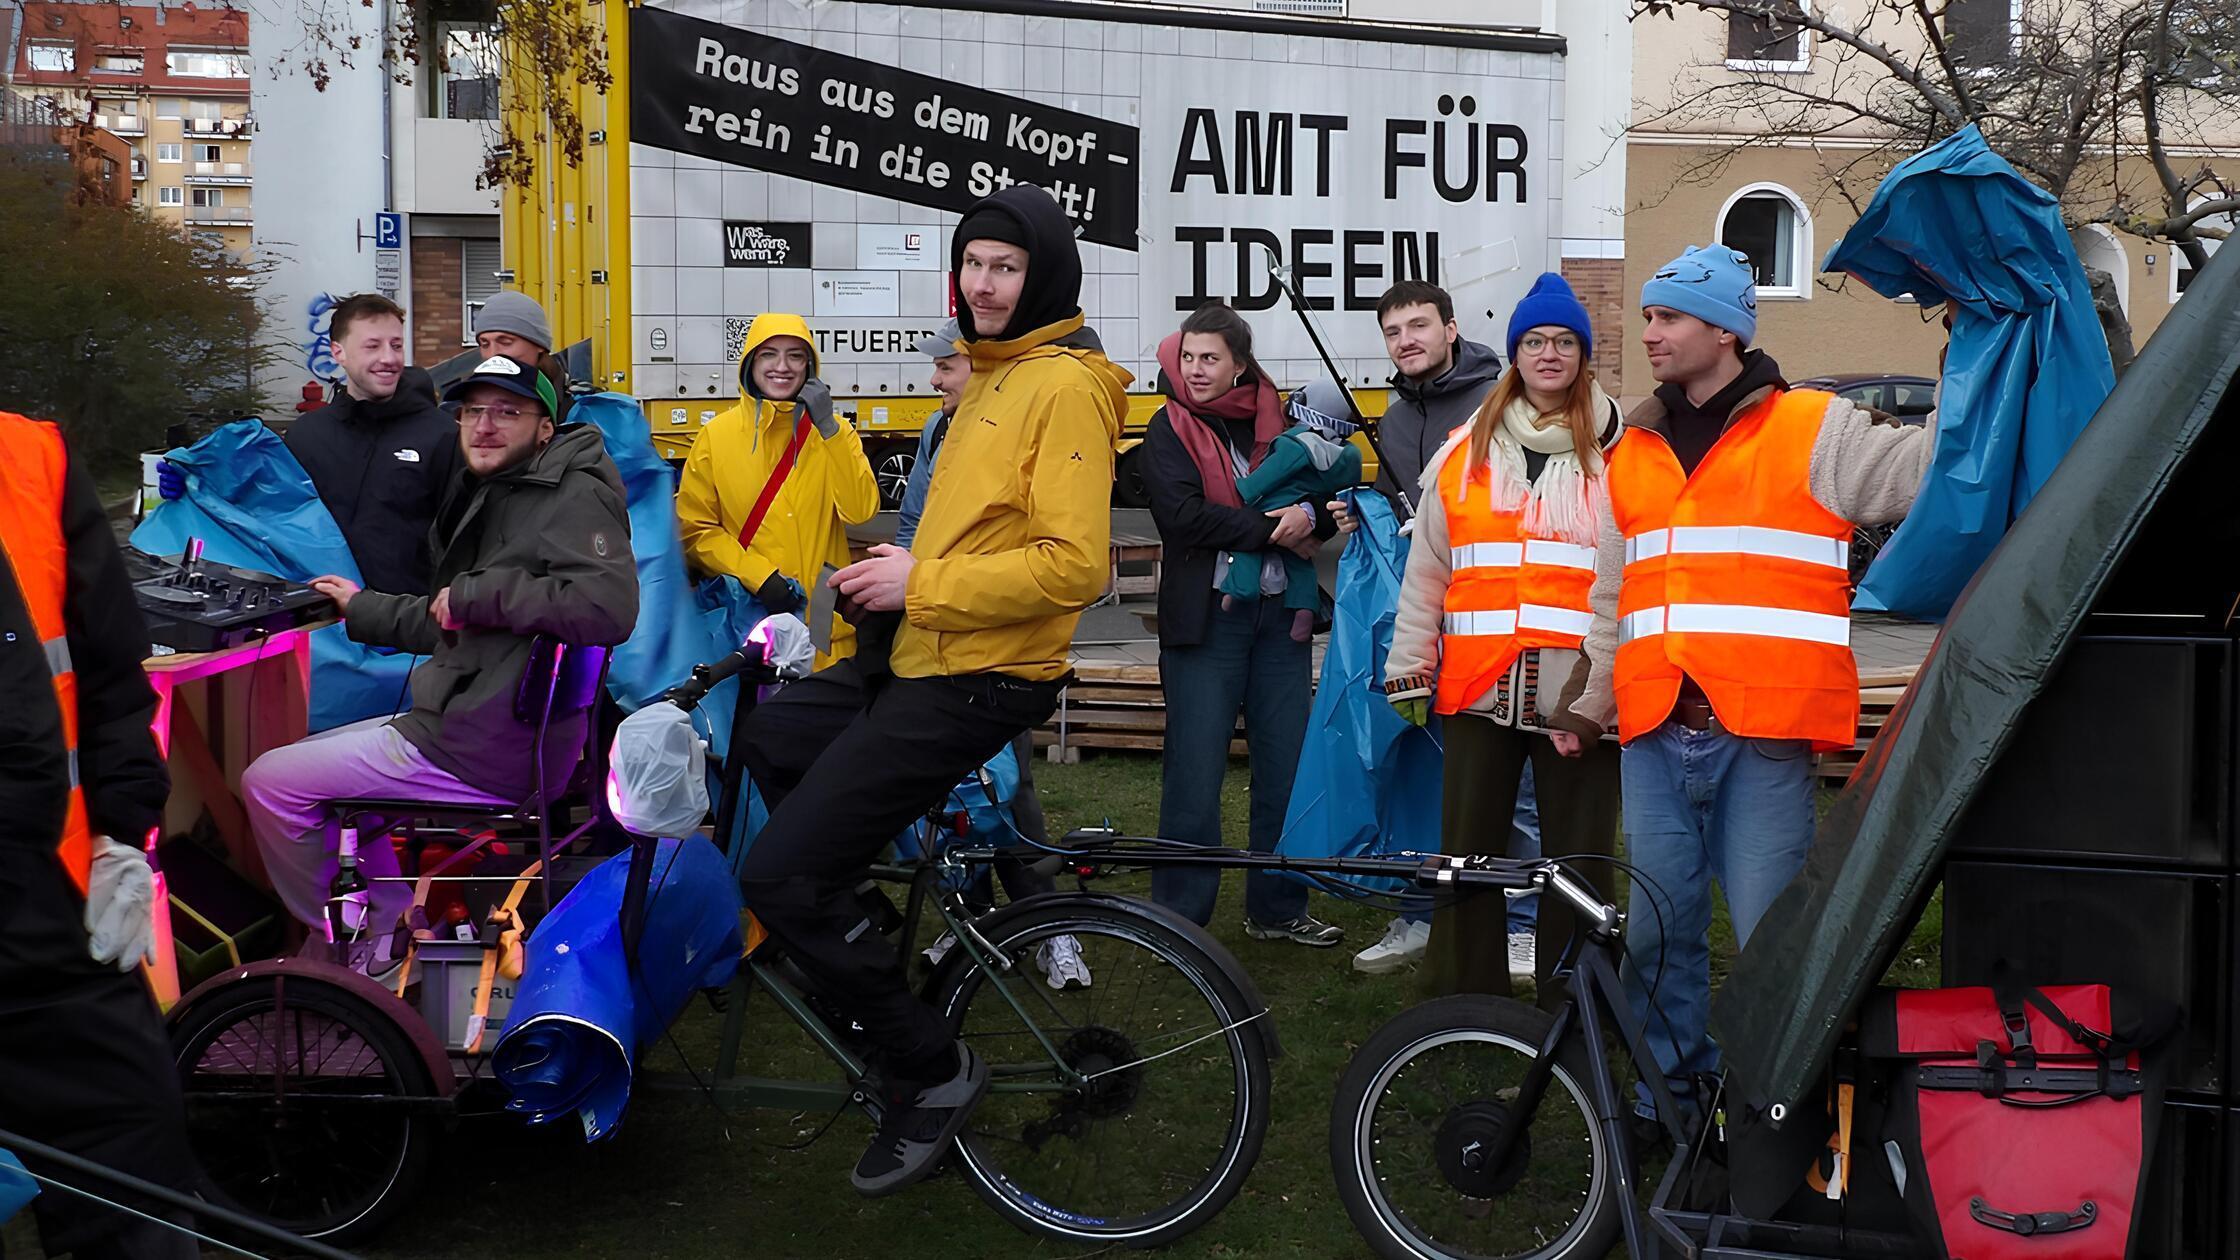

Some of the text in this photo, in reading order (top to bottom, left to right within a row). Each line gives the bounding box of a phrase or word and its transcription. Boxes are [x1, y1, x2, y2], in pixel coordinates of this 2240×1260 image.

[695, 37, 799, 96] Raus
[820, 78, 895, 118] aus
[914, 95, 990, 141] dem
[1006, 113, 1097, 166] Kopf
[1170, 94, 1528, 203] AMT FÜR
[684, 105, 1096, 221] rein in die Stt!
[379, 216, 395, 244] P
[1175, 226, 1439, 311] IDEEN
[809, 330, 936, 353] TFUERI
